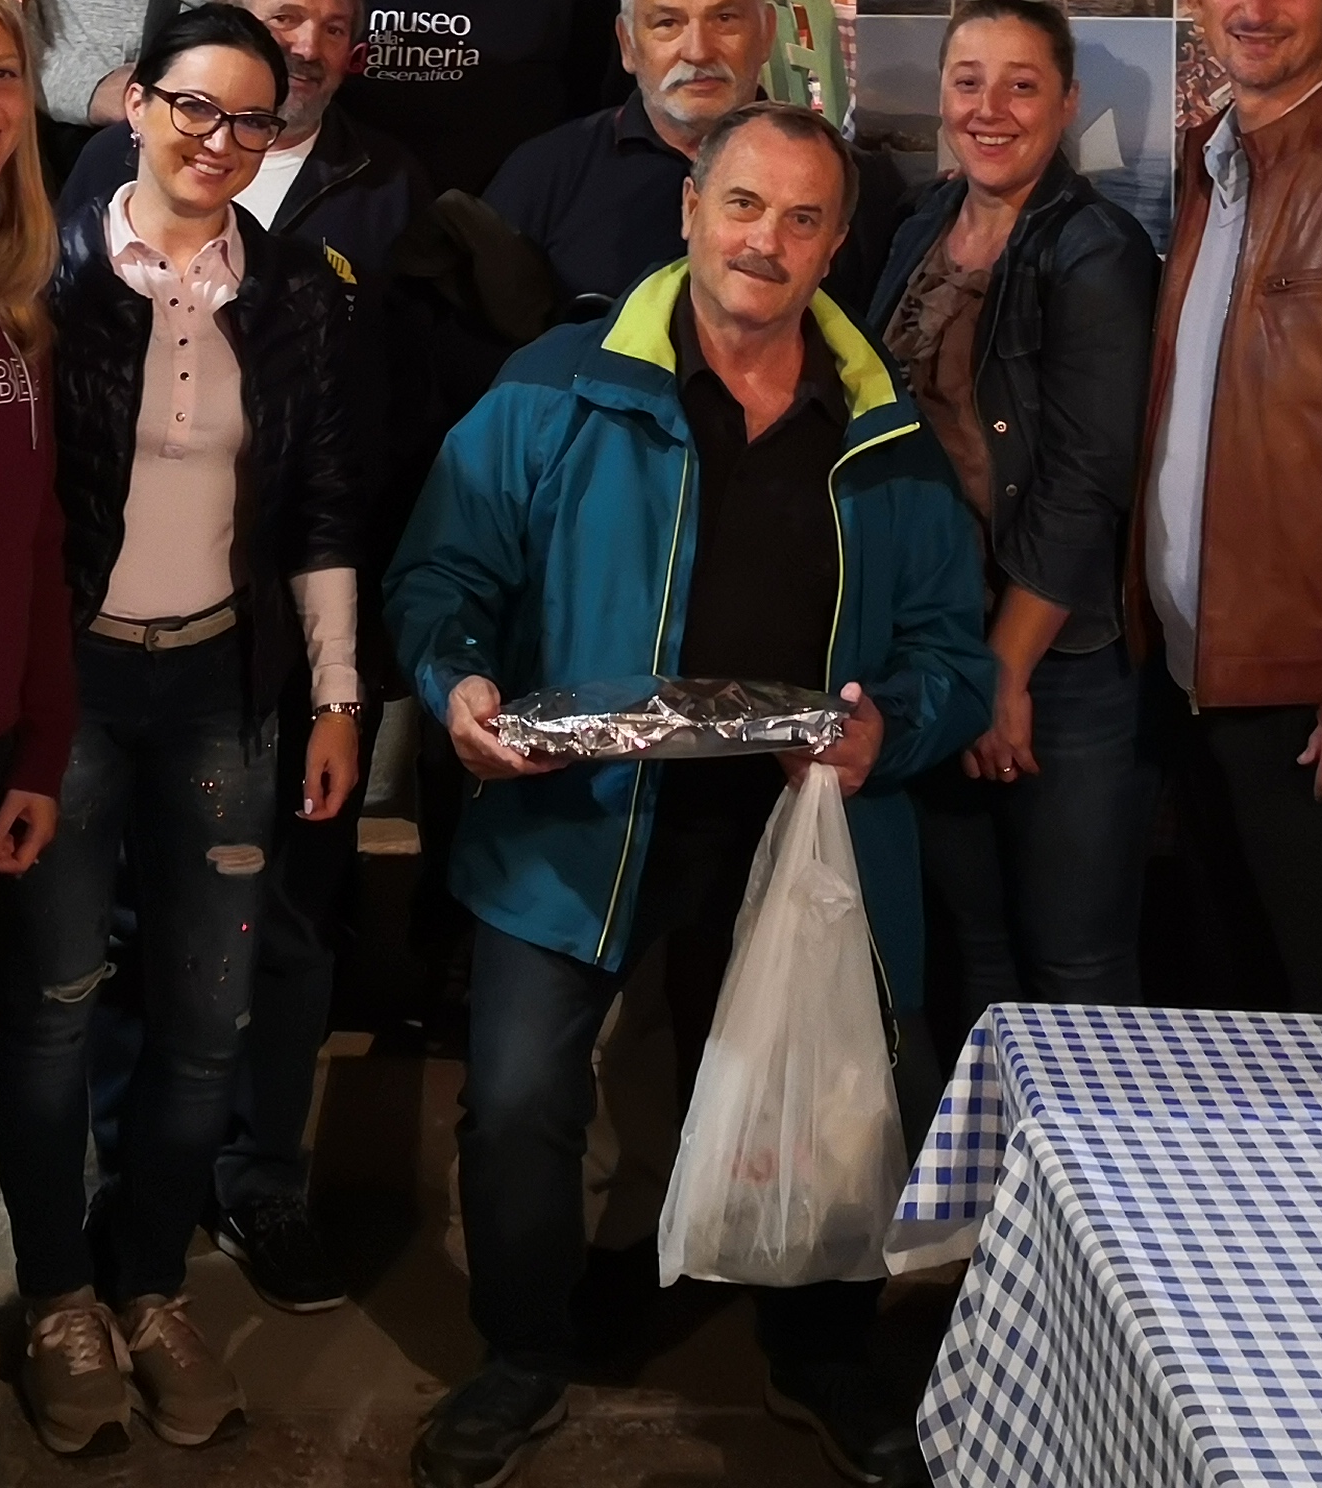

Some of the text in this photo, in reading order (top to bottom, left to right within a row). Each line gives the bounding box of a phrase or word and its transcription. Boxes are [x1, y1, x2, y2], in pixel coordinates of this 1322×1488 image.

[369, 10, 472, 36] museo
[368, 29, 399, 45] della
[366, 38, 480, 68] arineria
[363, 65, 464, 82] Cesenatico
